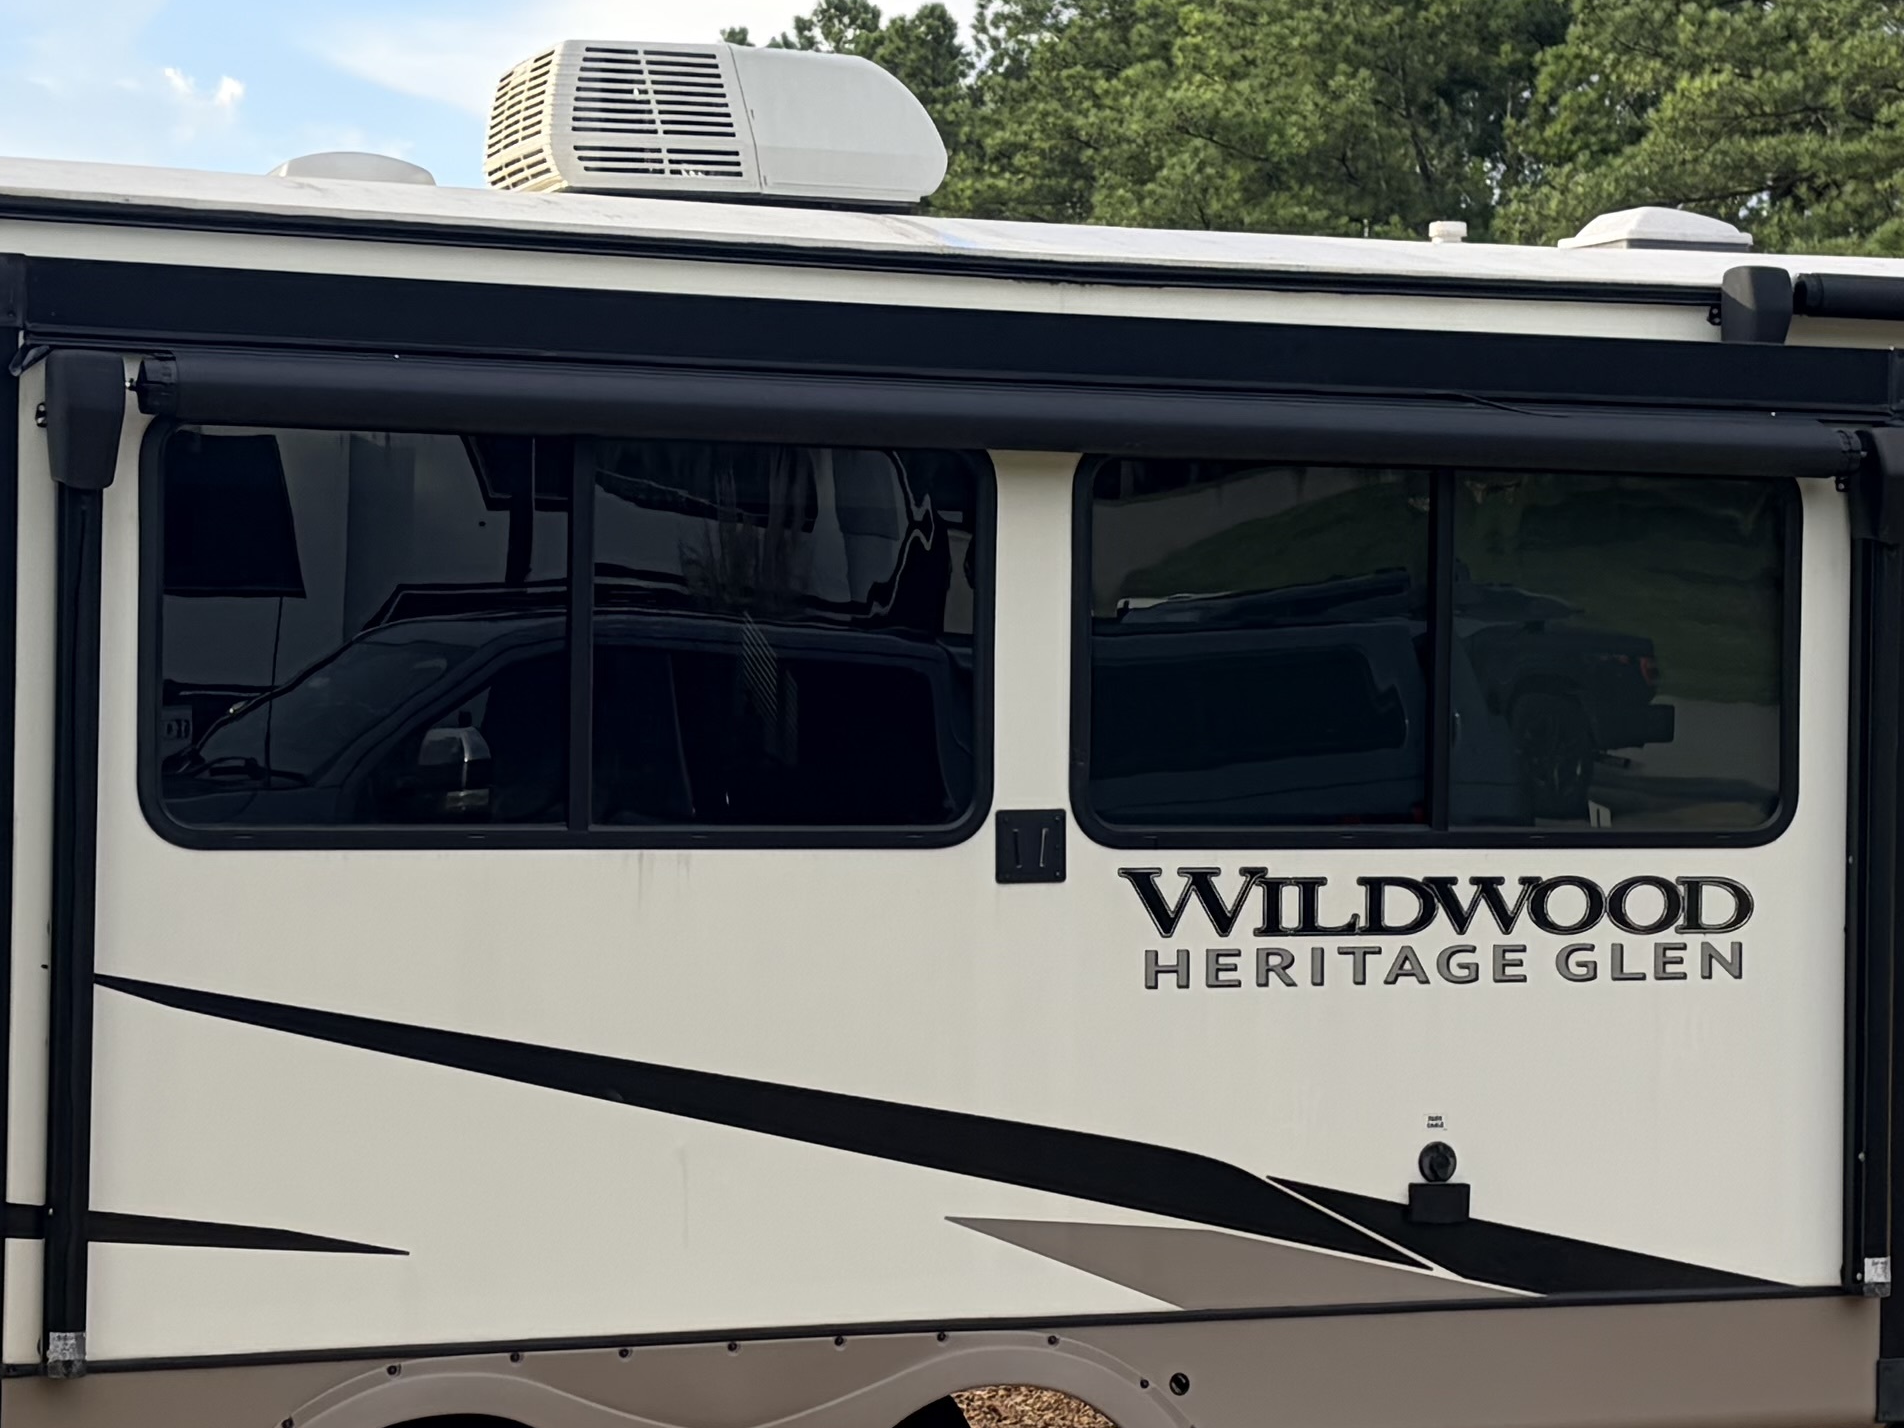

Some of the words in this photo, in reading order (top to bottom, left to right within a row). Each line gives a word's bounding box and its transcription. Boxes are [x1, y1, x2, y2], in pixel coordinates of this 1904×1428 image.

[1117, 866, 1755, 938] WILDWOOD
[1144, 943, 1528, 990] HERITAGE
[1555, 941, 1743, 983] GLEN
